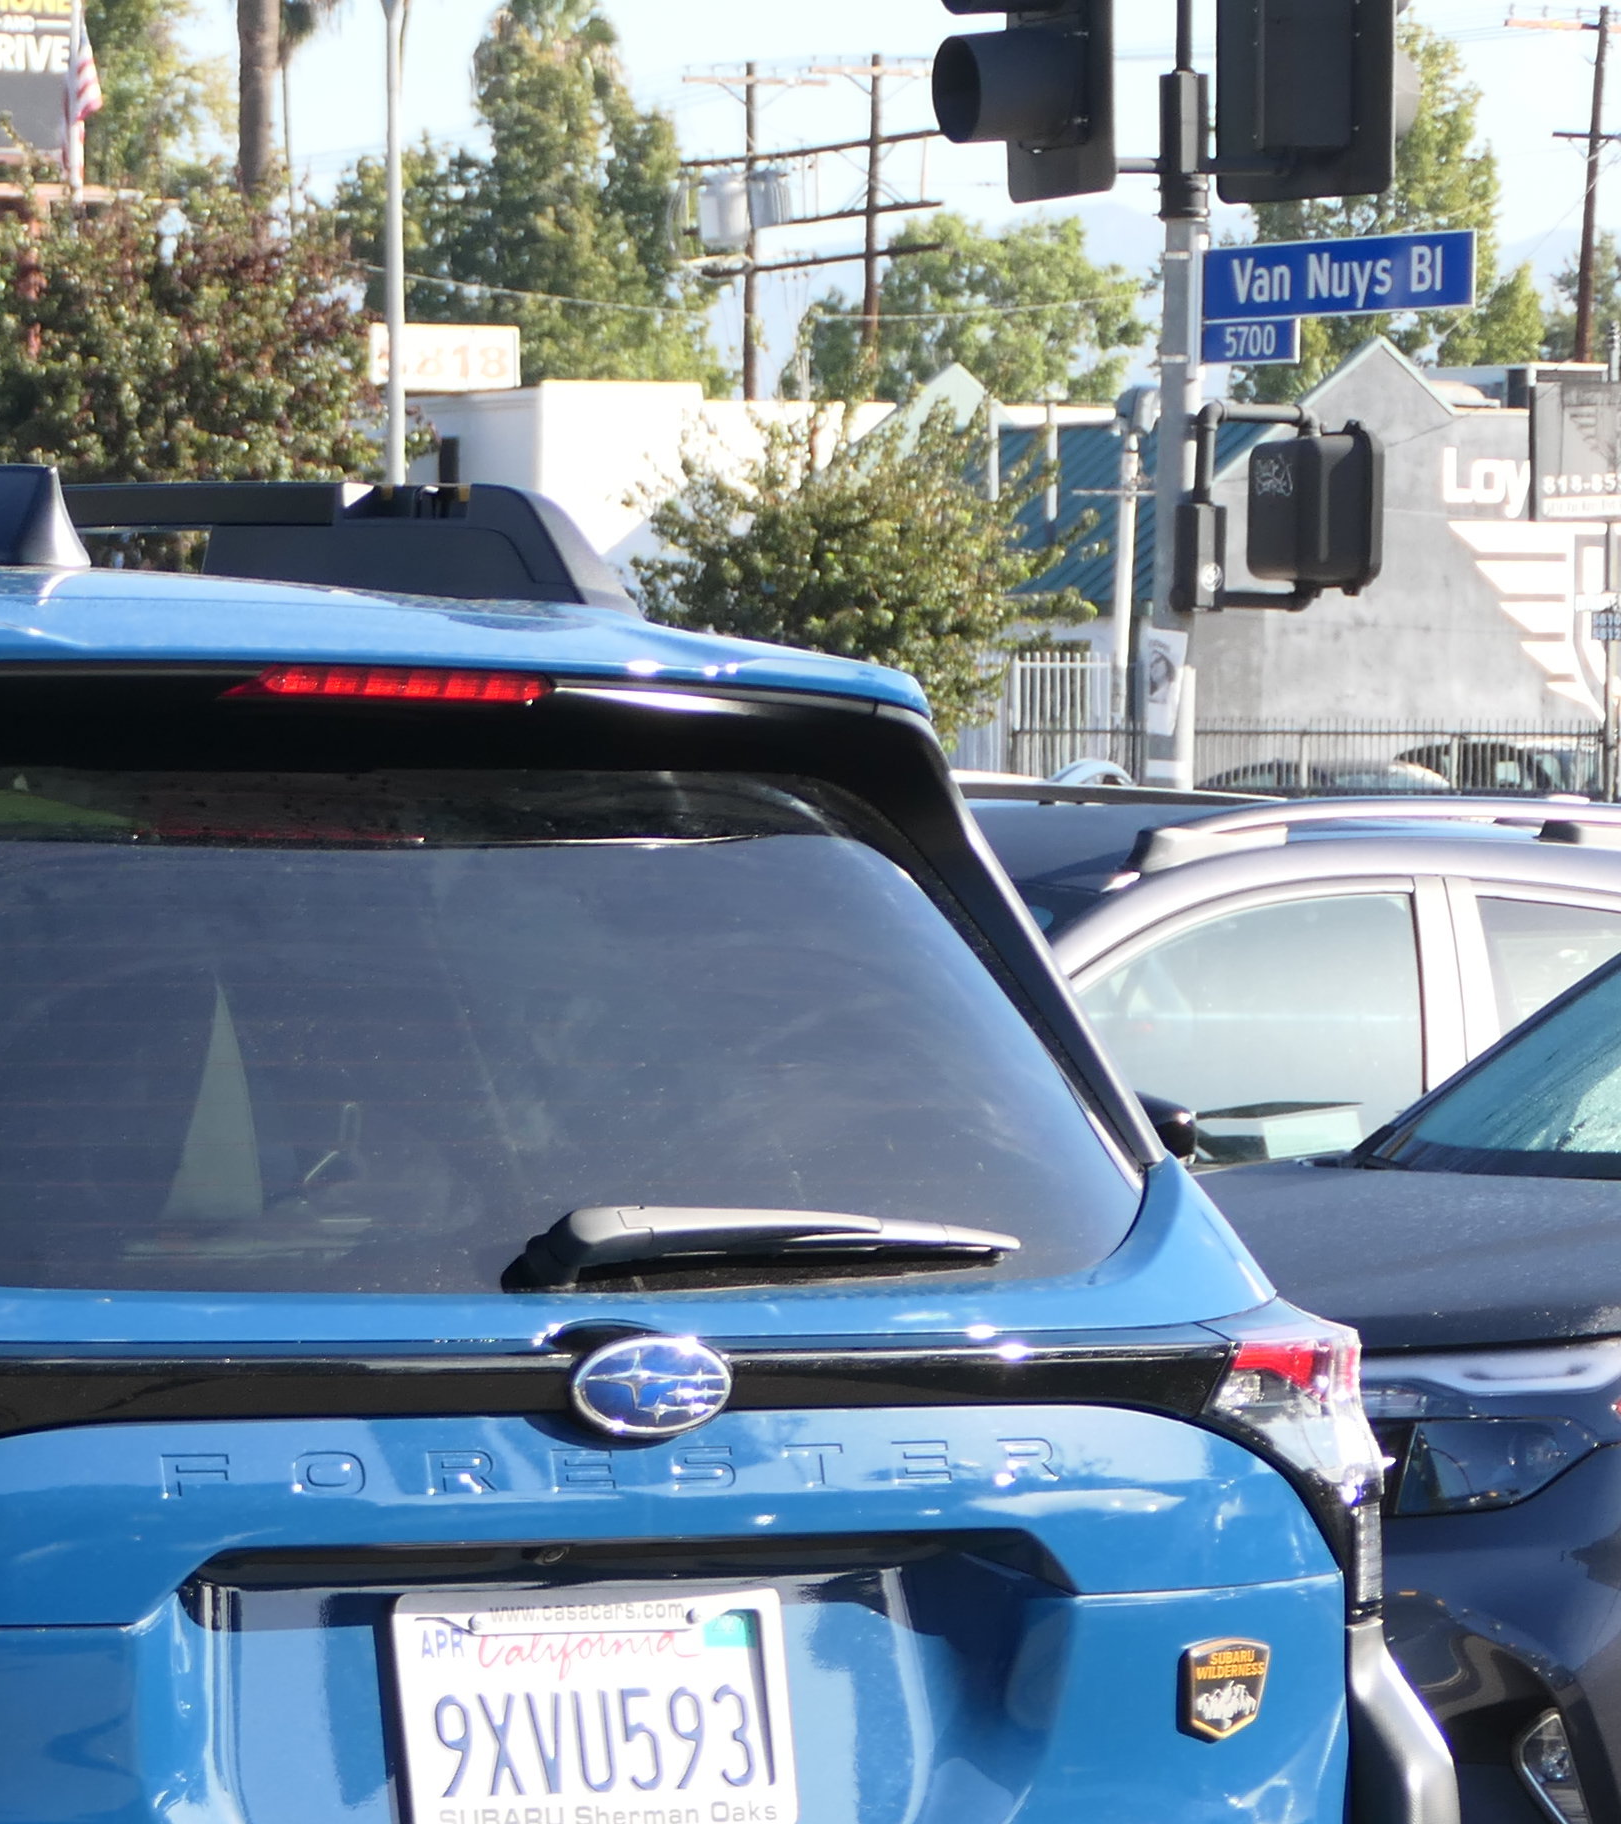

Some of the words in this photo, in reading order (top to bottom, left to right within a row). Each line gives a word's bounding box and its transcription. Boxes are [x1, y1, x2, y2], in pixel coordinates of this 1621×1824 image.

[1232, 257, 1291, 304] Van
[1308, 252, 1392, 309] Nuys
[1410, 245, 1443, 293] Bl
[1224, 325, 1276, 357] 5700
[161, 1437, 1061, 1498] FORESTER
[489, 1600, 686, 1624] www.casacars.com
[421, 1627, 466, 1659] APR
[477, 1630, 702, 1680] California
[1209, 1649, 1256, 1666] SUBARU
[1196, 1661, 1265, 1680] WILDERNESS
[434, 1684, 755, 1798] 9XVU593
[710, 1800, 778, 1824] Oaks
